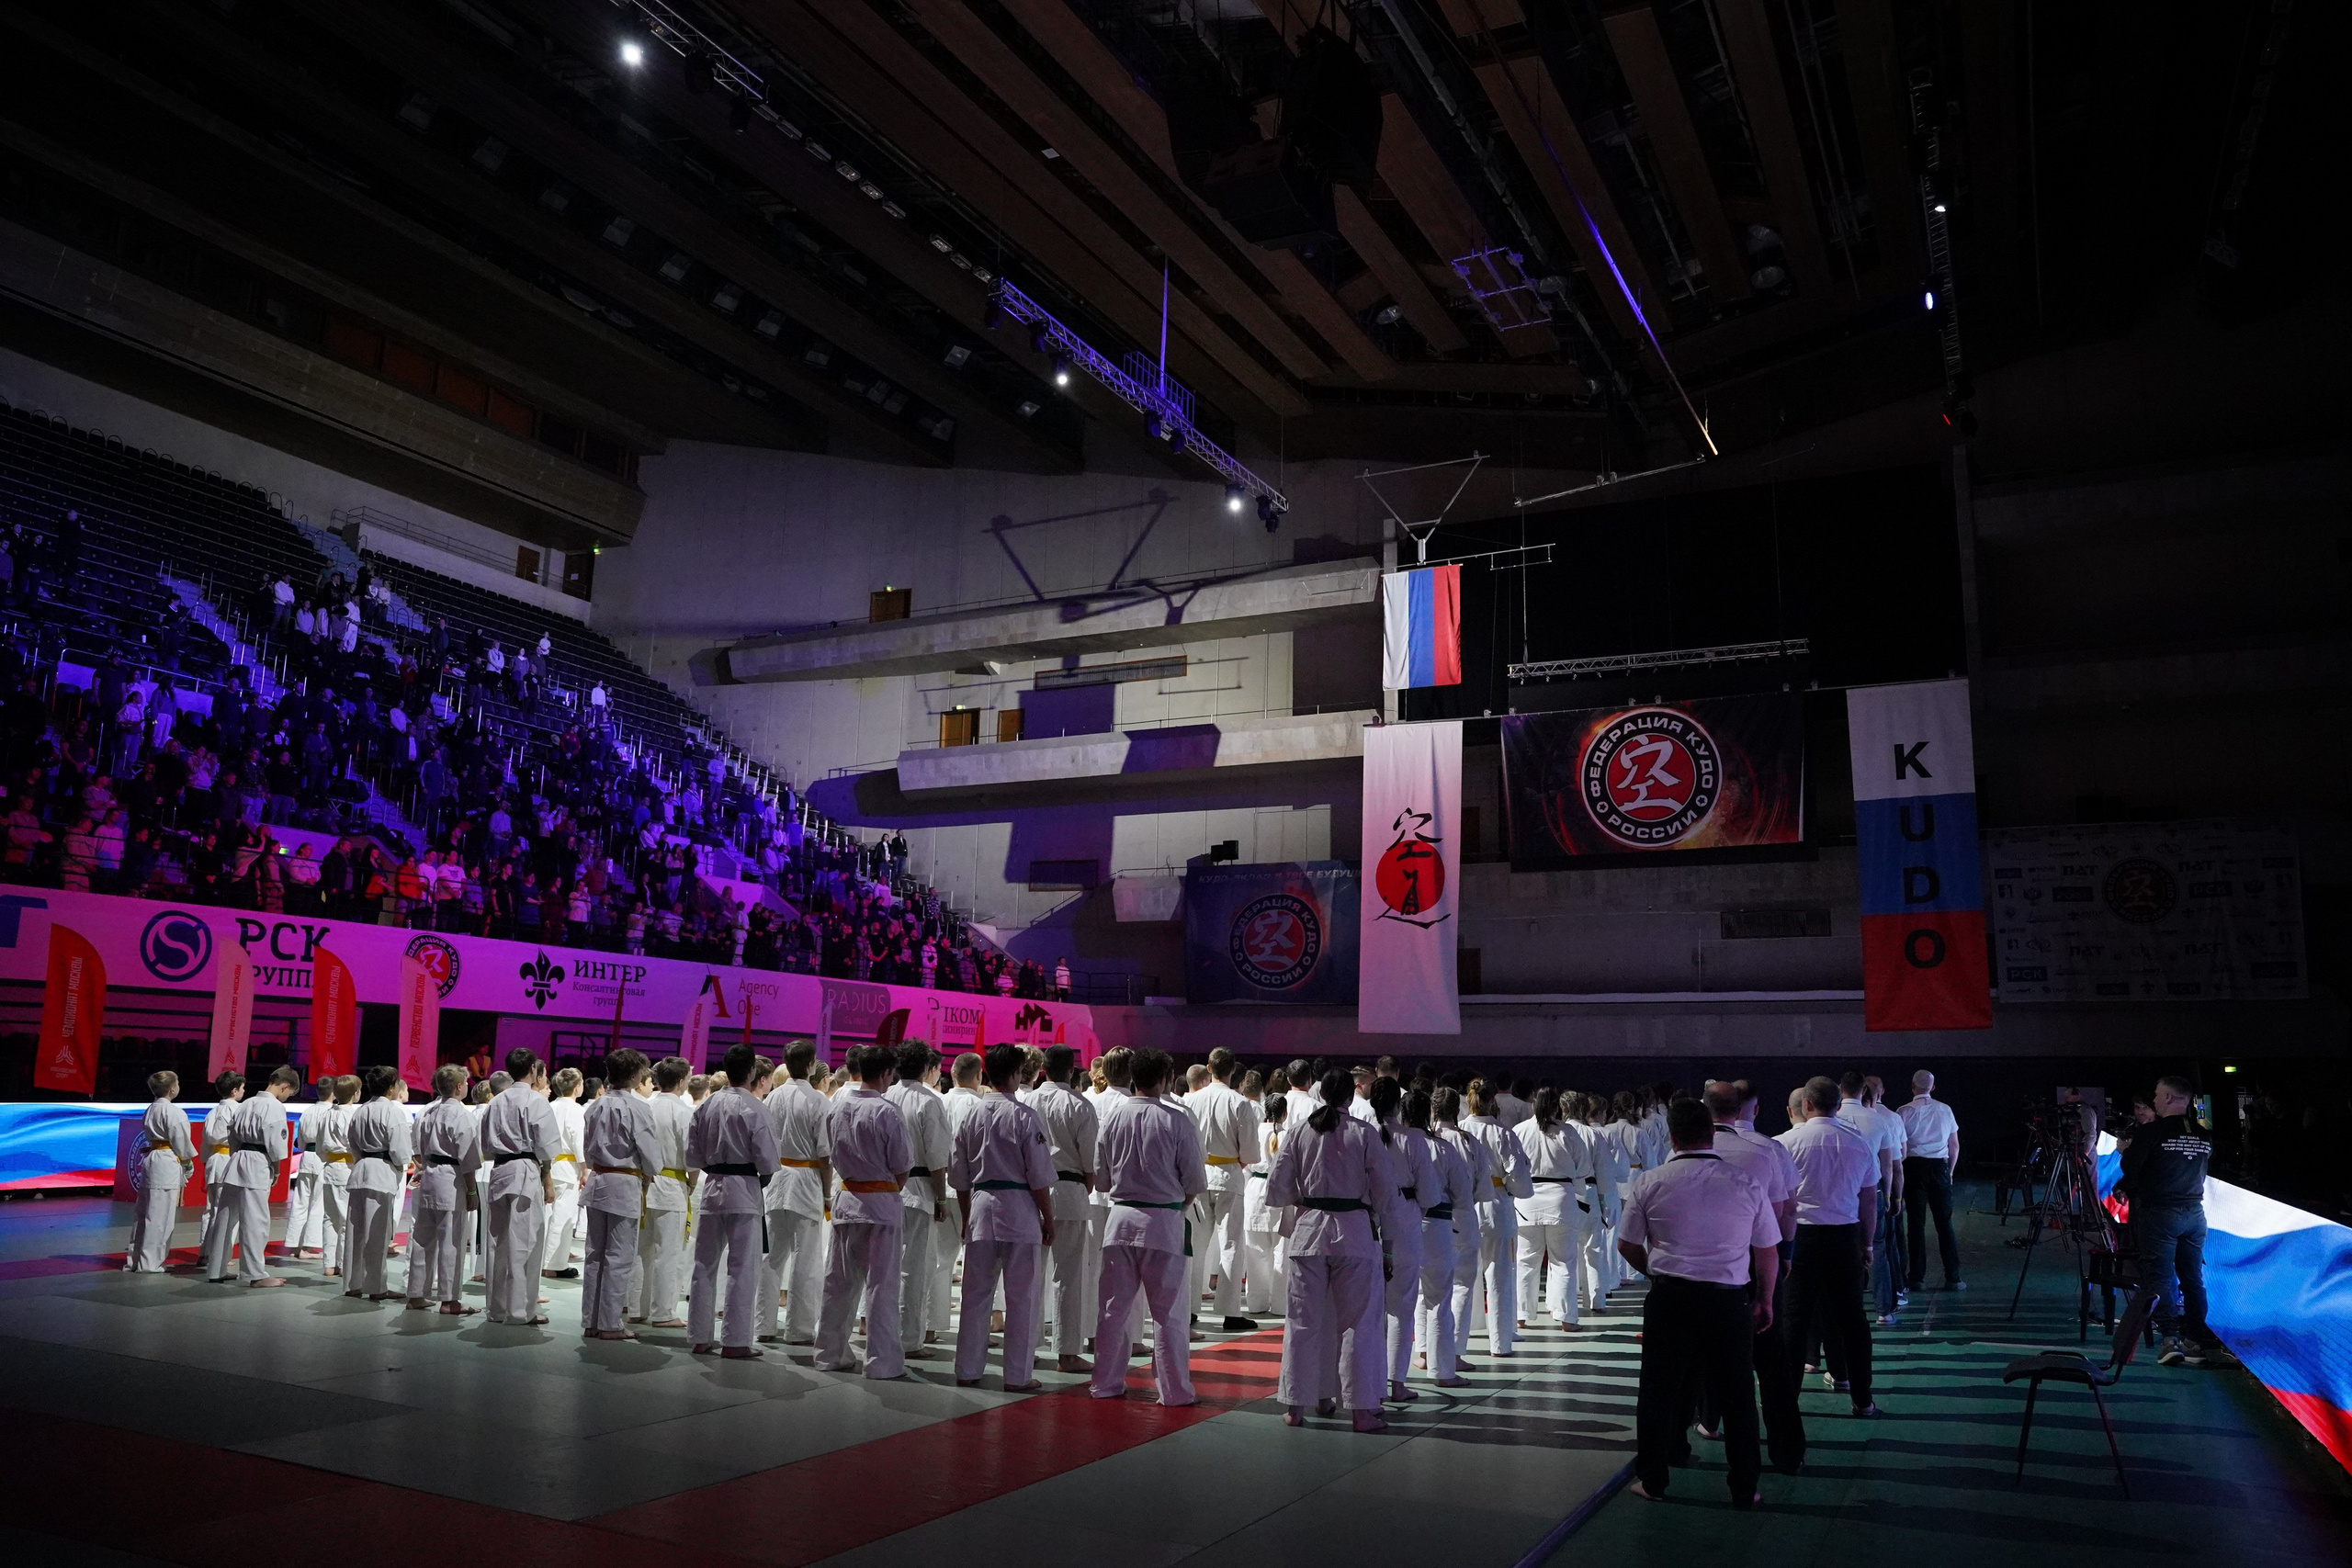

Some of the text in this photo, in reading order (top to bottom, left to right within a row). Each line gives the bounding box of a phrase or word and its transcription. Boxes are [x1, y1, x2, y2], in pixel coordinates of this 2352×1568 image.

[1589, 716, 1713, 798] ФЕДЕРАЦИЯ КУДО
[1608, 810, 1698, 840] РОССИИ
[1894, 740, 1946, 970] KUDO
[235, 918, 331, 963] РСК
[1232, 897, 1317, 953] ФЕДЕРАЦИЯ КУДО
[233, 964, 243, 995] МОСКВЫ
[574, 960, 647, 982] ИНТЕР
[739, 979, 780, 999] Agency
[1241, 964, 1303, 985] РОССИИ
[62, 956, 83, 1038] ЧЕМПИОНАТ МОСКВЫ
[325, 965, 342, 1045] ЧЕМПИОНАТ МОСКВЫ
[410, 974, 426, 1049] ПЕРВЕНСТВО МОСКВЫ
[738, 999, 761, 1016] Oe
